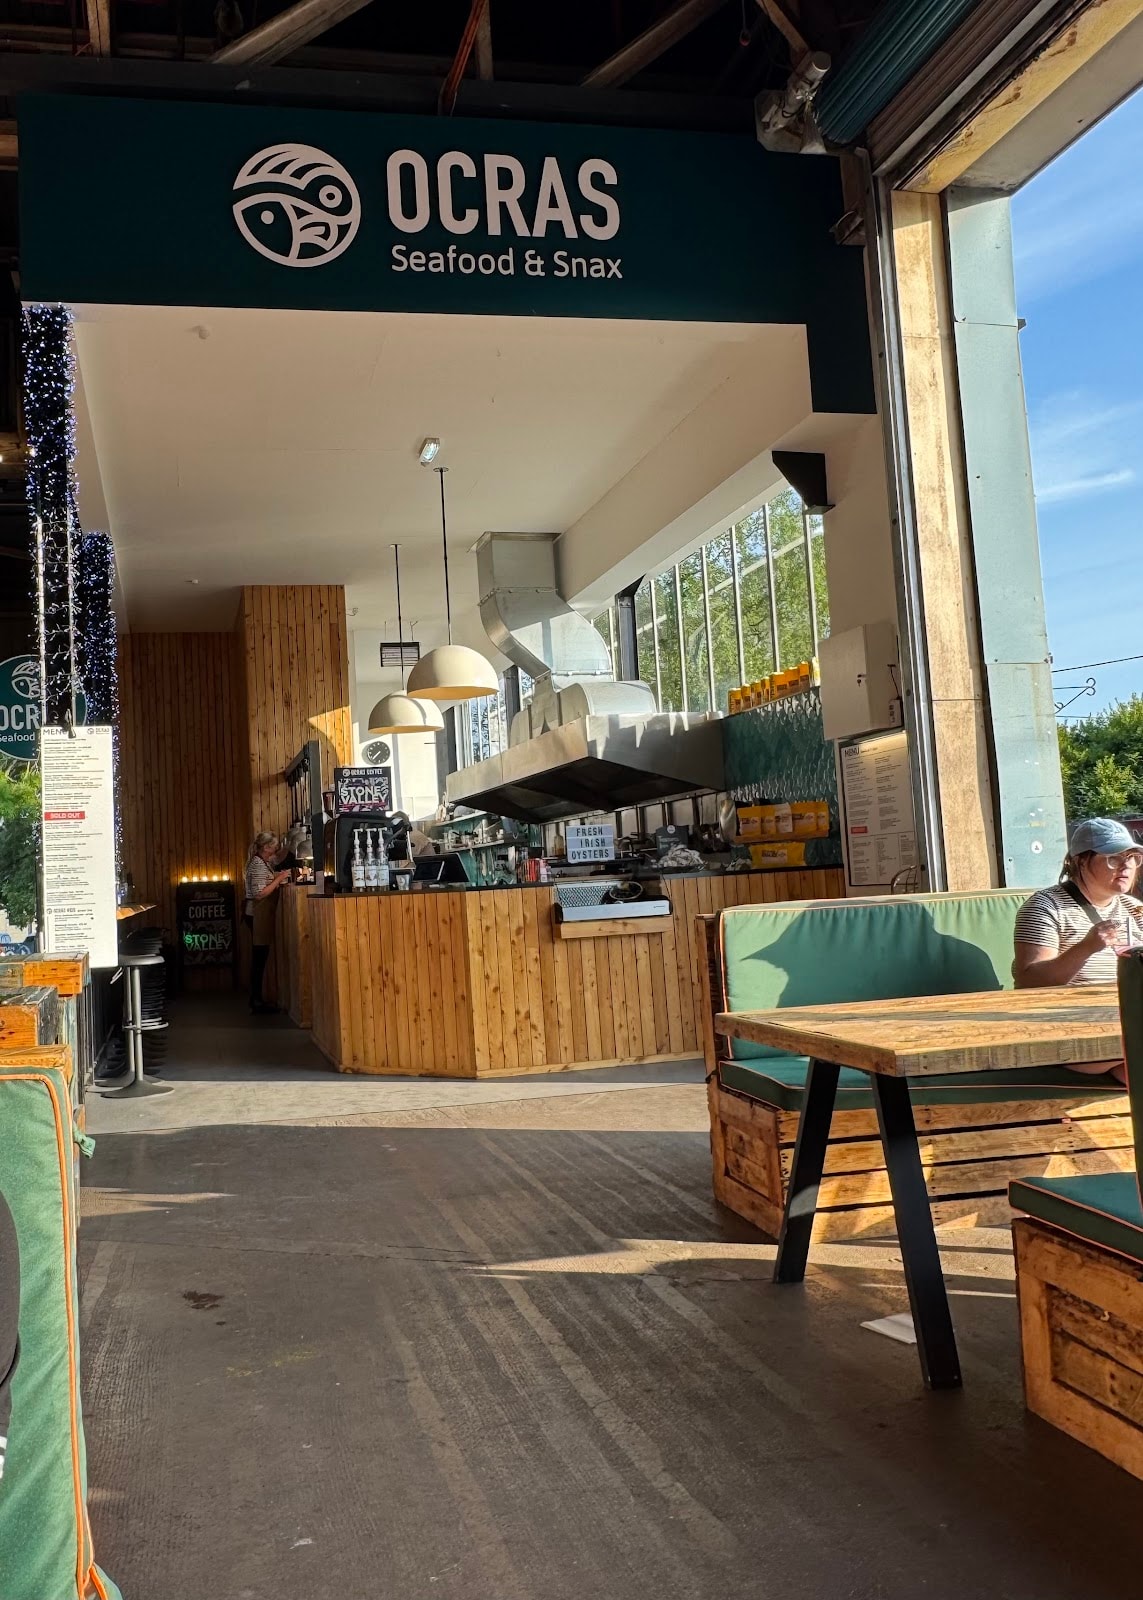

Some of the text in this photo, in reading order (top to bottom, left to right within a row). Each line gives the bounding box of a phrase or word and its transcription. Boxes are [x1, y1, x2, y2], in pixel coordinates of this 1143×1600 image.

[387, 149, 620, 241] OCRAS
[391, 244, 623, 279] Seafood & Snax
[0, 704, 41, 730] OCR
[341, 785, 381, 797] STONE
[341, 793, 387, 804] VALLEY
[576, 826, 603, 837] FRESH
[580, 838, 606, 848] IRISH
[571, 849, 610, 860] OYSTERS
[188, 904, 226, 919] COFFEE
[185, 932, 225, 943] STONE
[185, 940, 231, 950] VALLEY
